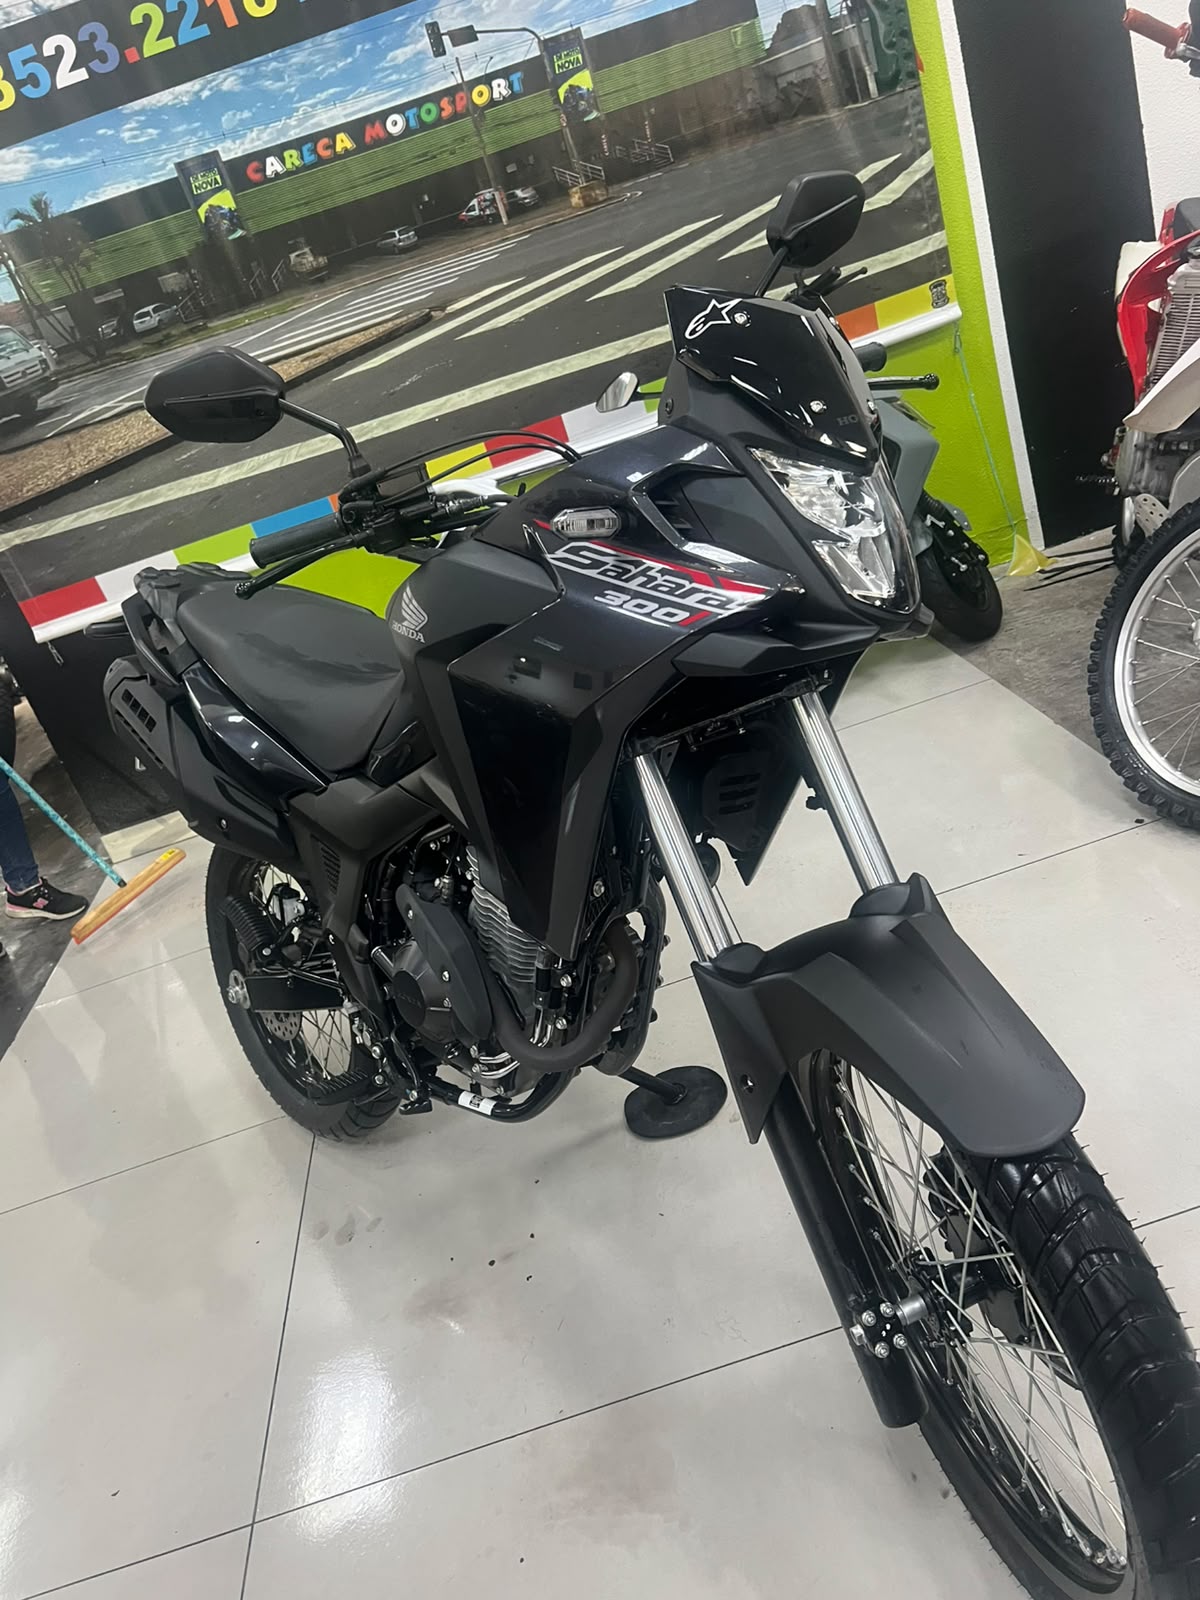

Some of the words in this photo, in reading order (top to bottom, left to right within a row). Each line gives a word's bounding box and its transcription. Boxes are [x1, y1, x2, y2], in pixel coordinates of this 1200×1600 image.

[556, 55, 582, 72] NOVA
[246, 132, 356, 183] CARECA
[364, 72, 524, 144] MOTOSPORT
[193, 177, 221, 193] NOVA
[548, 541, 748, 618] Sahara
[594, 590, 690, 623] 300
[391, 620, 425, 643] HONDA
